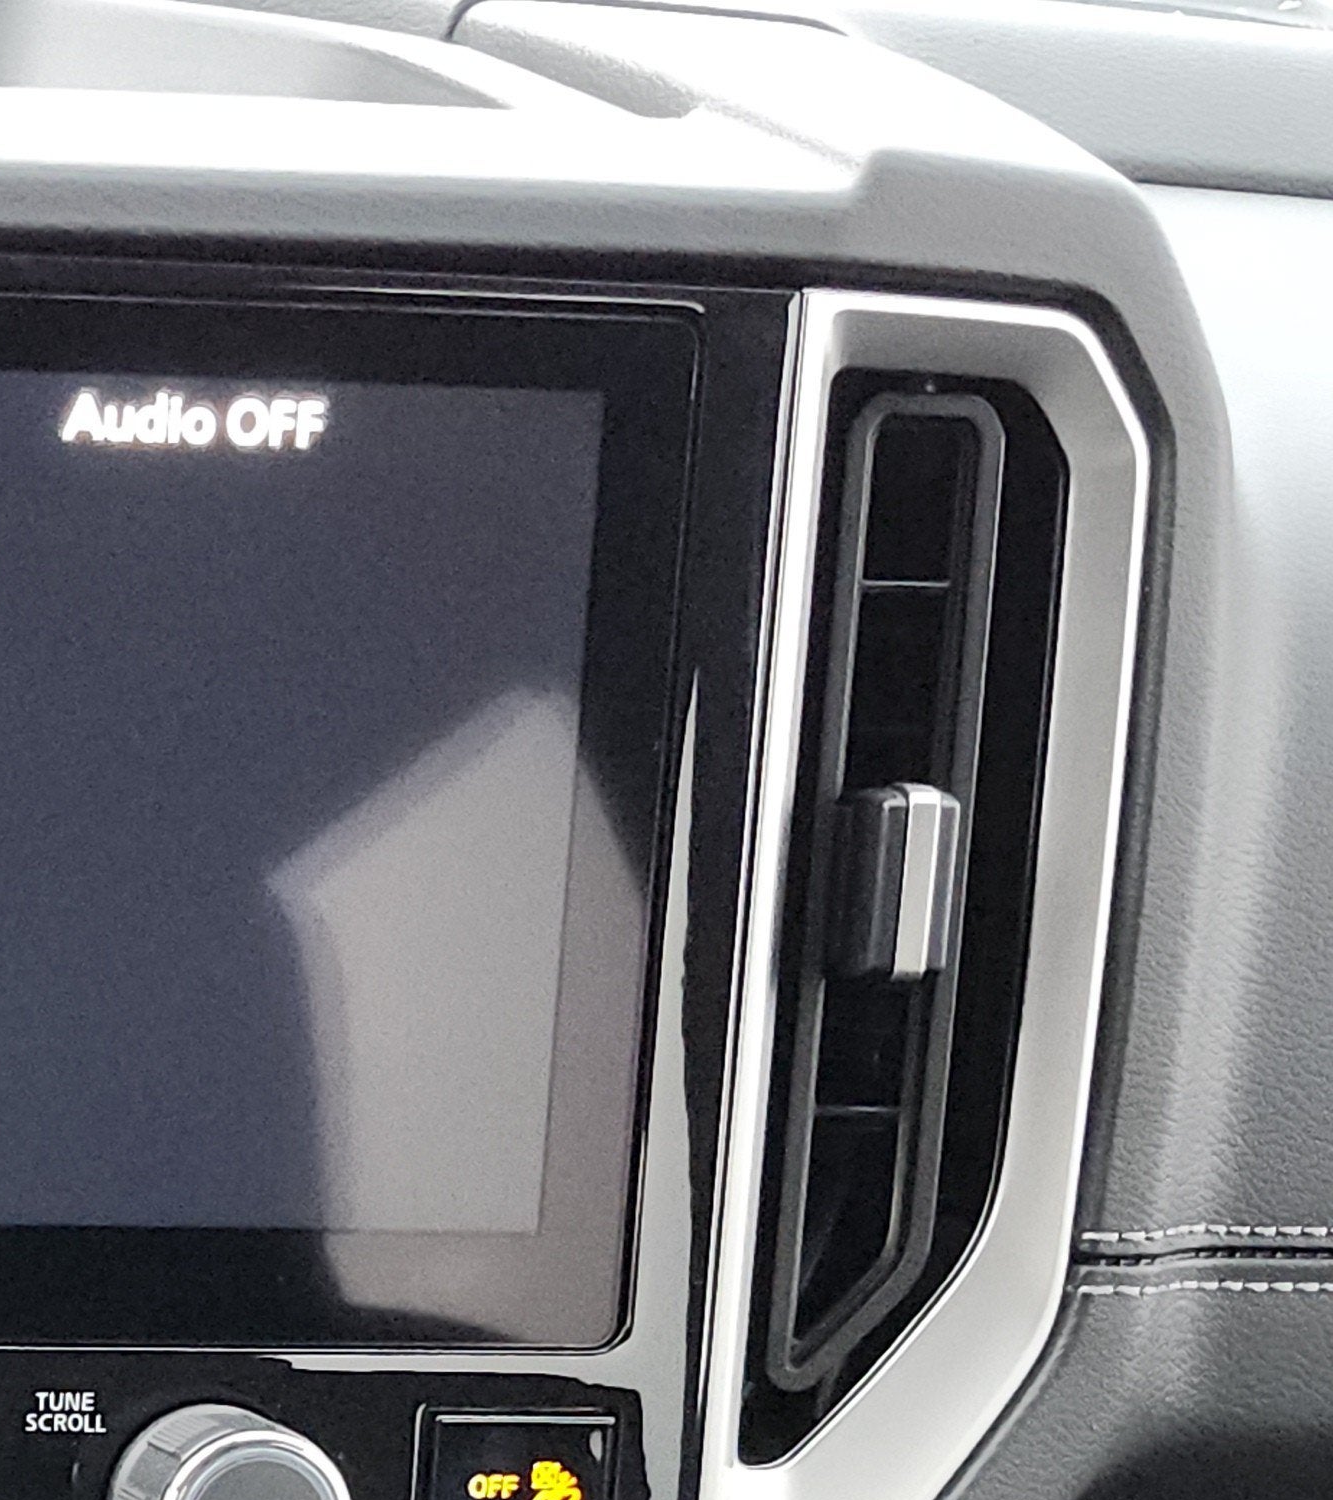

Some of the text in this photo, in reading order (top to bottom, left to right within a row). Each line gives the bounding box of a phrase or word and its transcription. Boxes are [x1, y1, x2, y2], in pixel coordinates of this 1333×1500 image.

[62, 392, 327, 451] Audio OFF
[36, 1392, 96, 1412] TUNE
[26, 1414, 108, 1434] SCROLL
[468, 1474, 521, 1500] OFF
